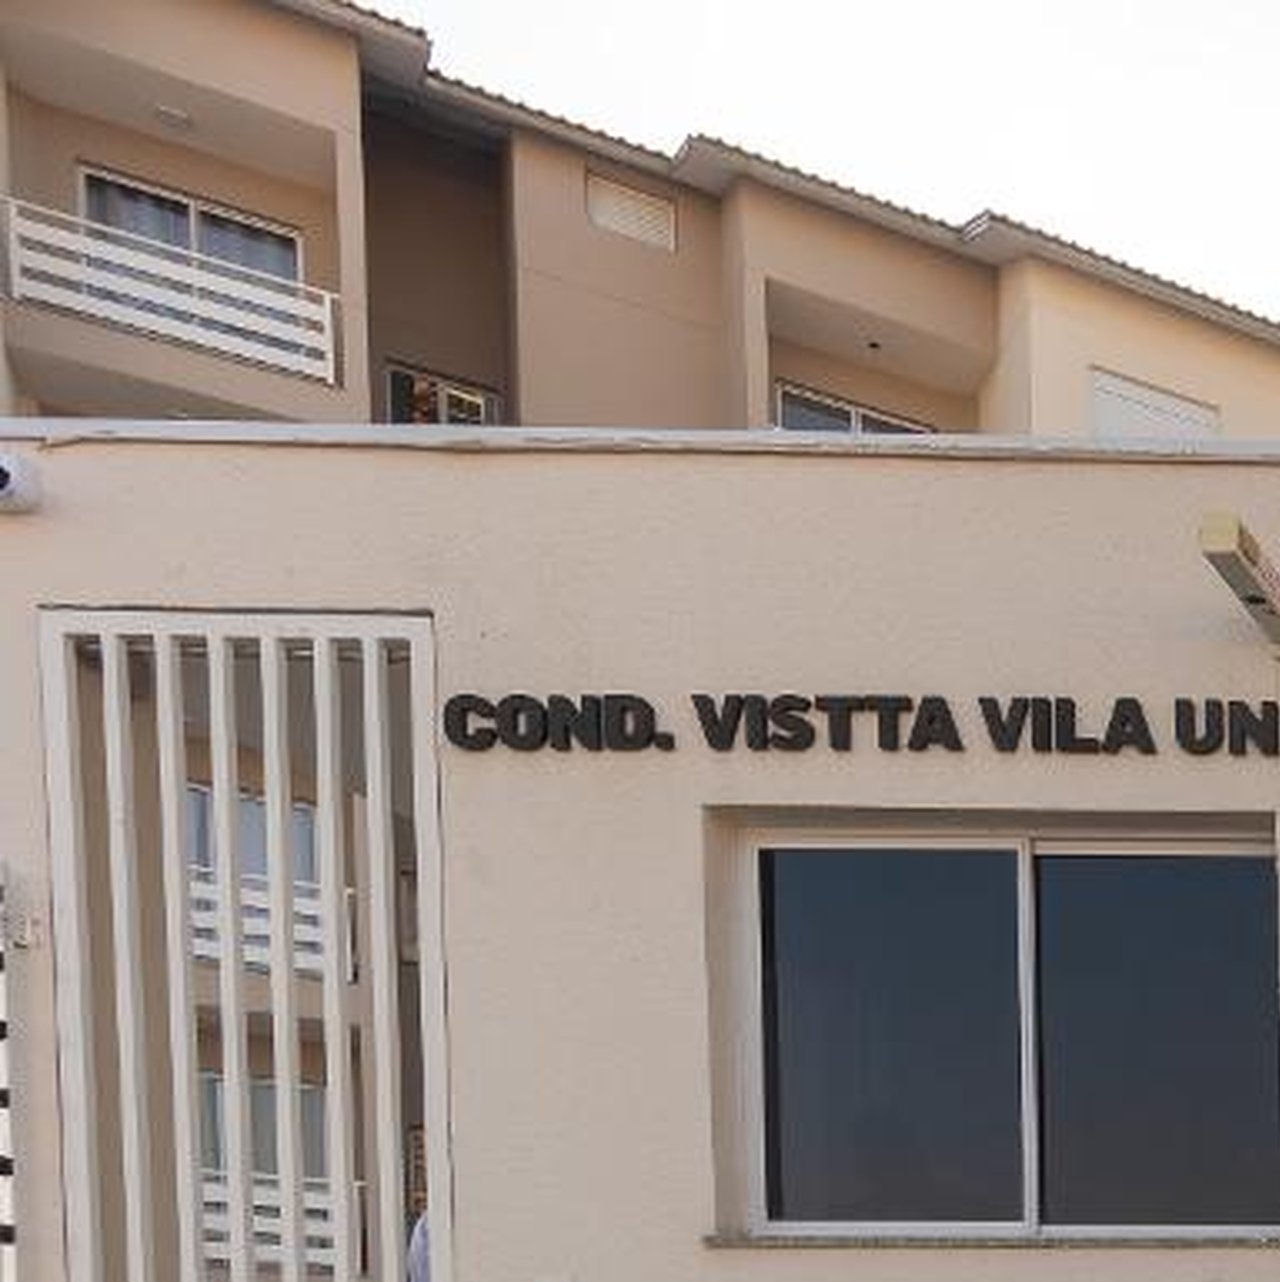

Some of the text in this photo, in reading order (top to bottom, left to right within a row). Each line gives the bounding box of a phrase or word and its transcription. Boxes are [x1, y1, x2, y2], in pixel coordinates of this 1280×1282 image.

[444, 692, 676, 755] COND.
[691, 693, 966, 755] VISTTA
[977, 695, 1158, 757] VILA
